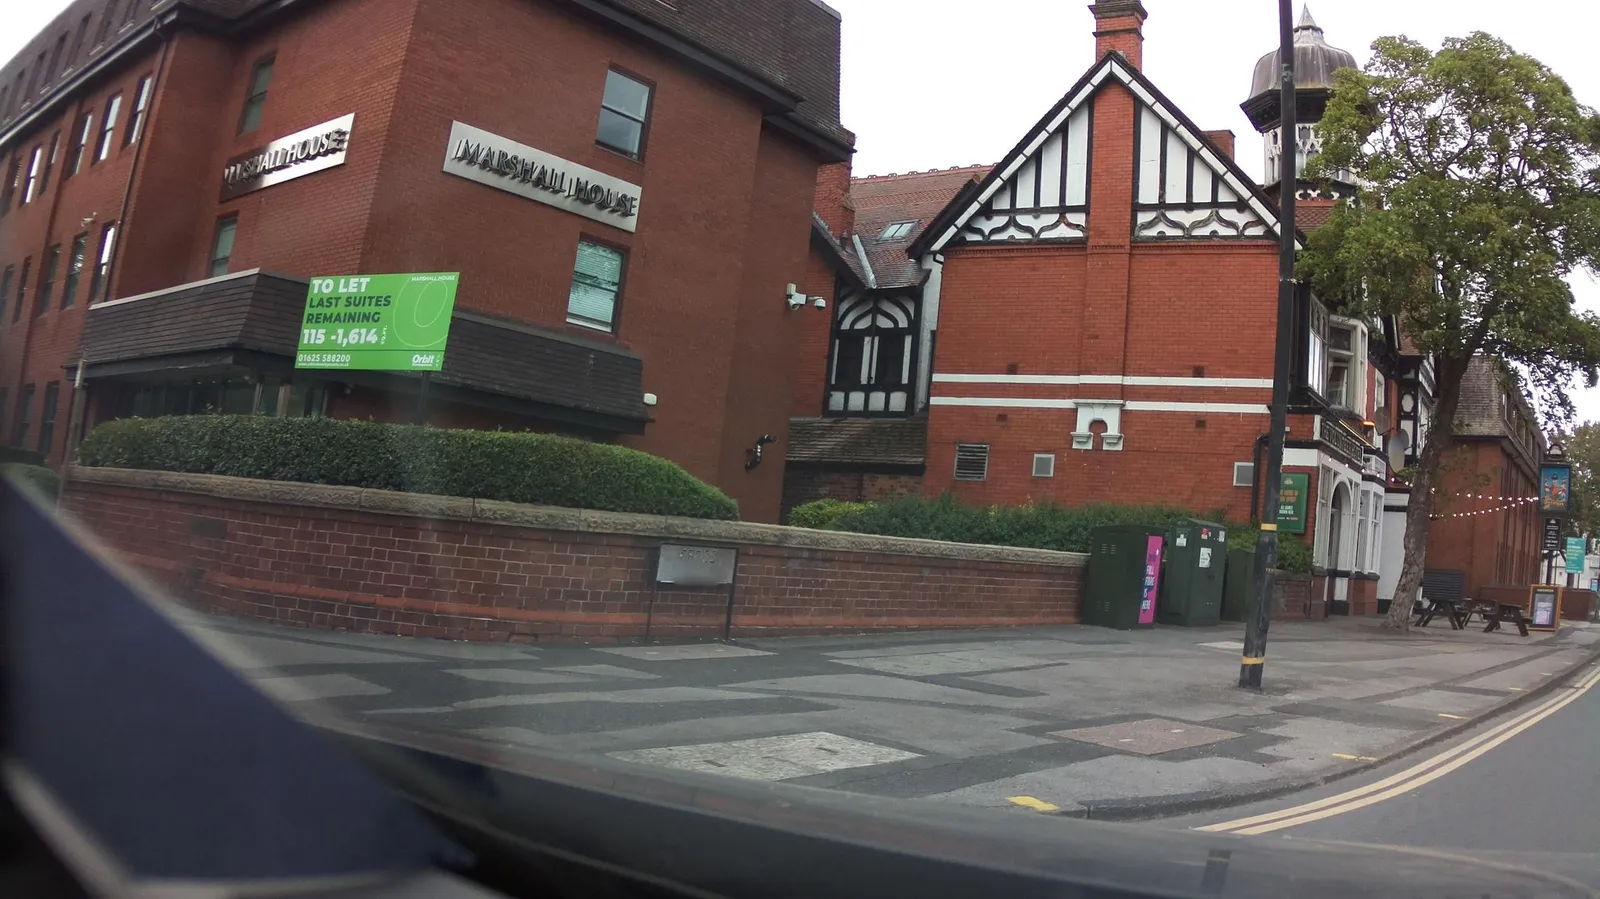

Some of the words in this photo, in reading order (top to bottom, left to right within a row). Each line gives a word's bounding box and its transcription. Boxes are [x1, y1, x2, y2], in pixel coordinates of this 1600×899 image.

[286, 128, 349, 163] HOUSE
[453, 138, 566, 192] MARSHALL
[567, 175, 638, 217] HOUSE
[312, 279, 334, 294] TO
[338, 277, 370, 293] LET
[309, 296, 341, 309] LAST
[344, 295, 392, 308] SUITES
[306, 311, 381, 325] REMAINING
[303, 328, 326, 344] 115
[298, 354, 320, 362] 01625
[322, 354, 351, 362] 588200
[412, 354, 435, 364] Orbit
